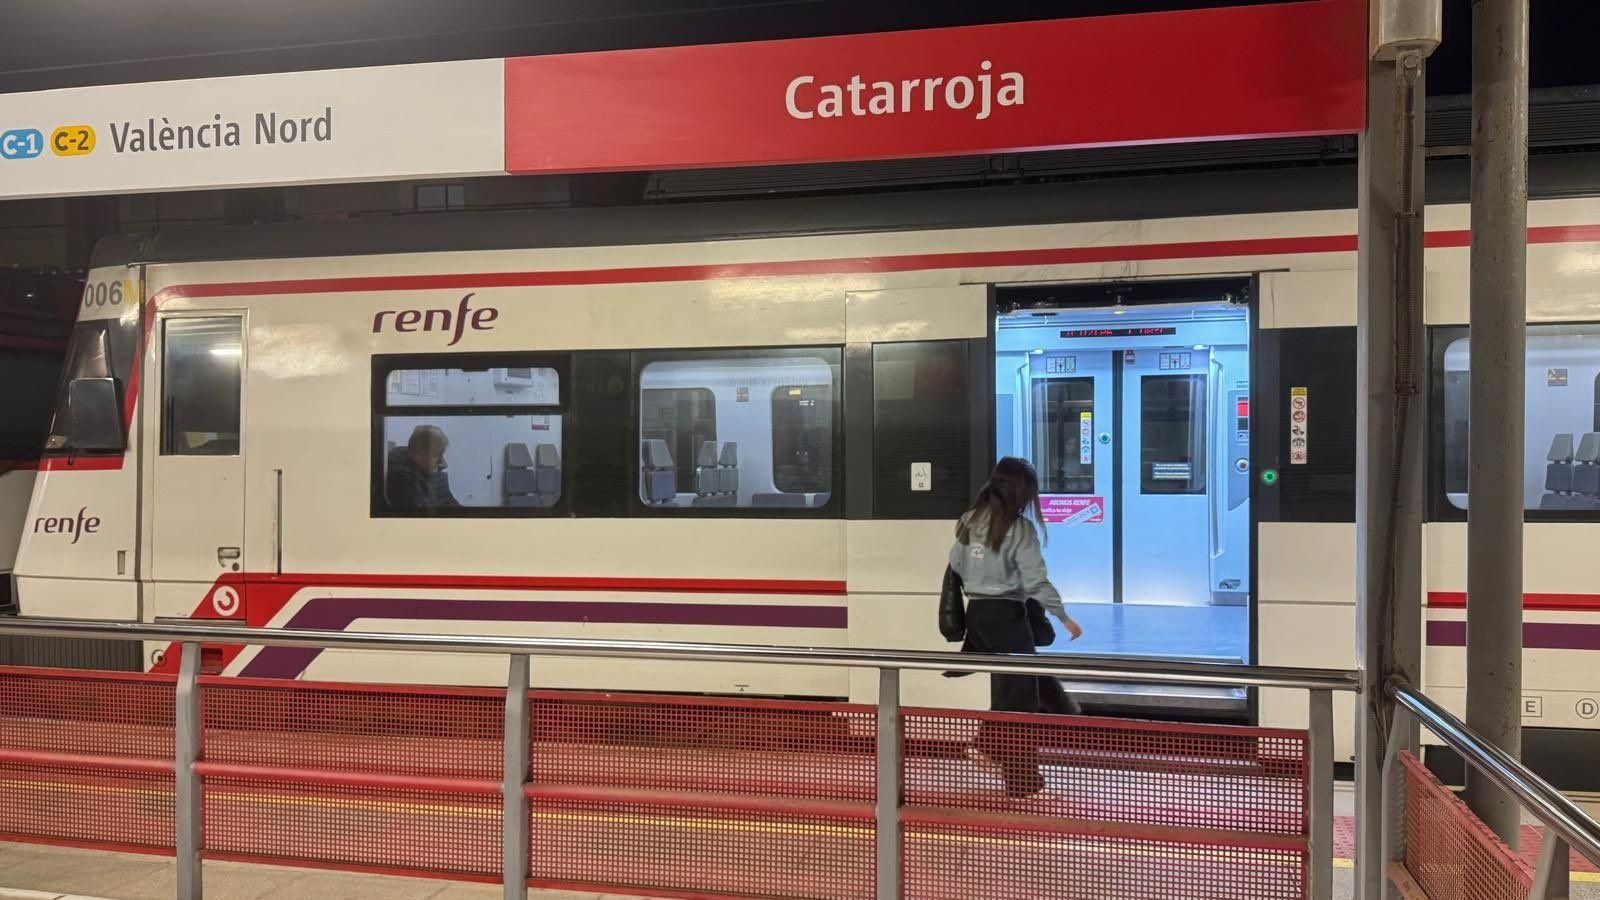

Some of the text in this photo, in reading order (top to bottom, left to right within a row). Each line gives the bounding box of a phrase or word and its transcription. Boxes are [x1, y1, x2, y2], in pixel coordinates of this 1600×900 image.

[785, 60, 1025, 120] Catarroja
[2, 107, 333, 155] C-1 C-2 València Nord
[372, 293, 500, 345] renfe
[34, 506, 101, 544] renfe
[1525, 700, 1594, 715] E D
